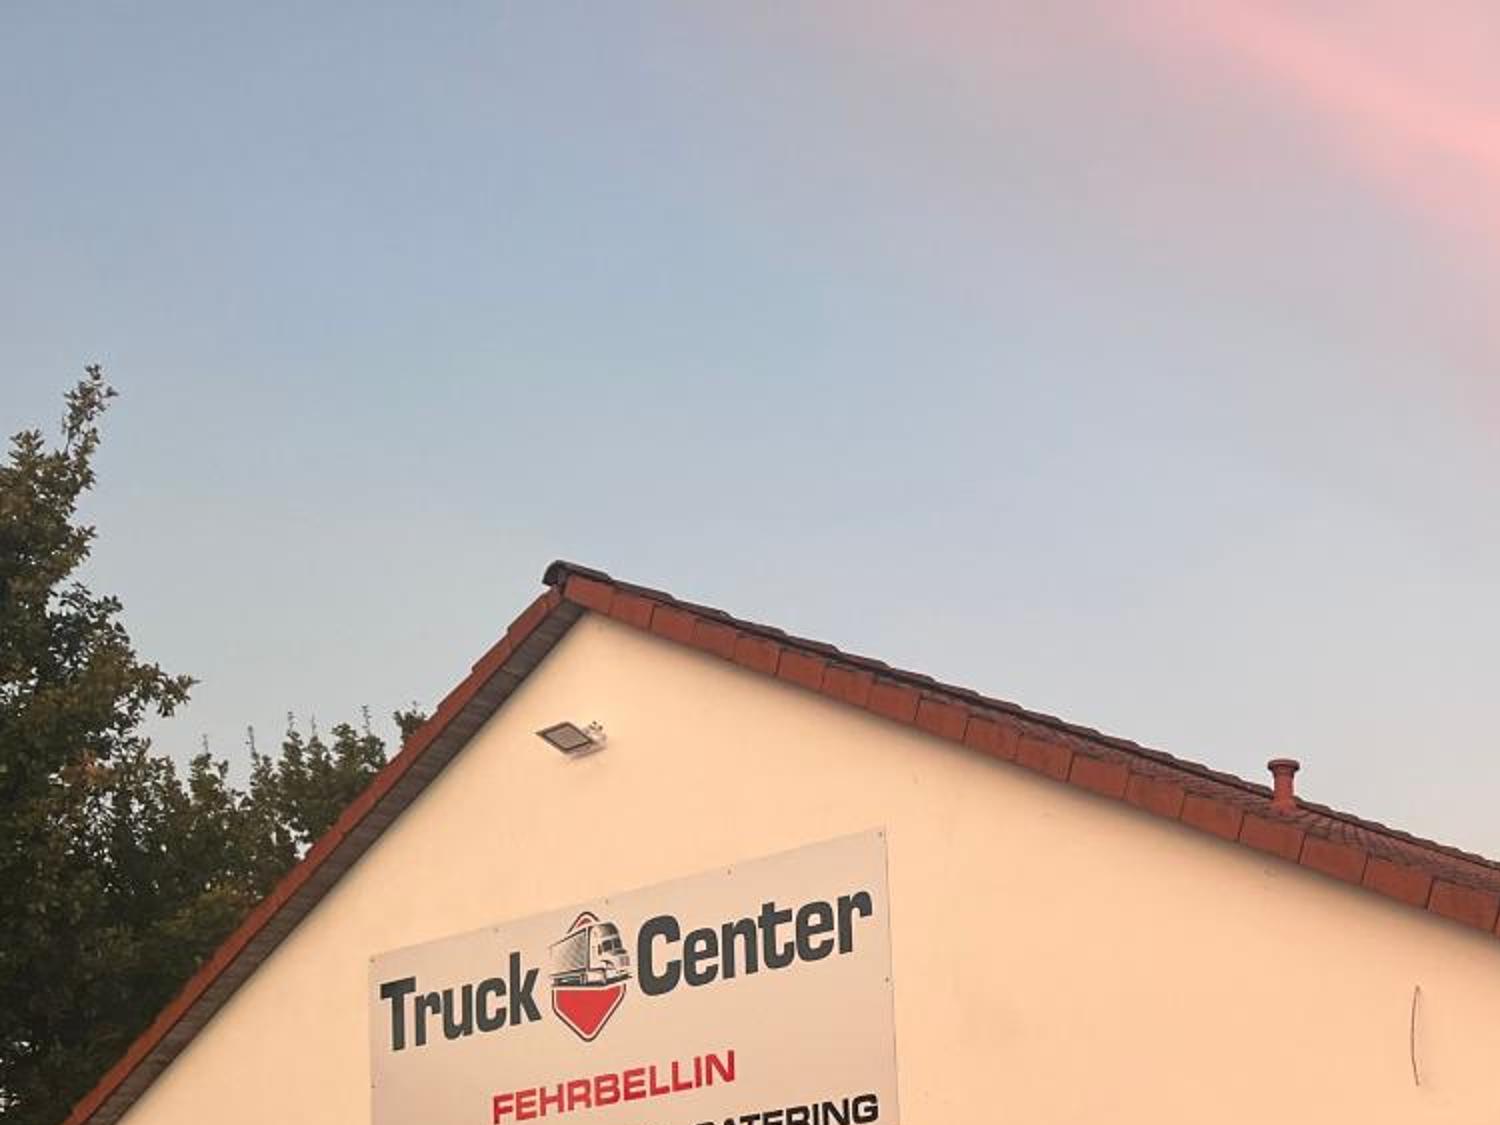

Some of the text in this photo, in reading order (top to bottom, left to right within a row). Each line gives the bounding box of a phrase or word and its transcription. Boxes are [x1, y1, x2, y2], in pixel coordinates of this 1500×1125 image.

[379, 891, 873, 1051] Truck Center
[492, 1049, 735, 1125] FEHRBELLIN
